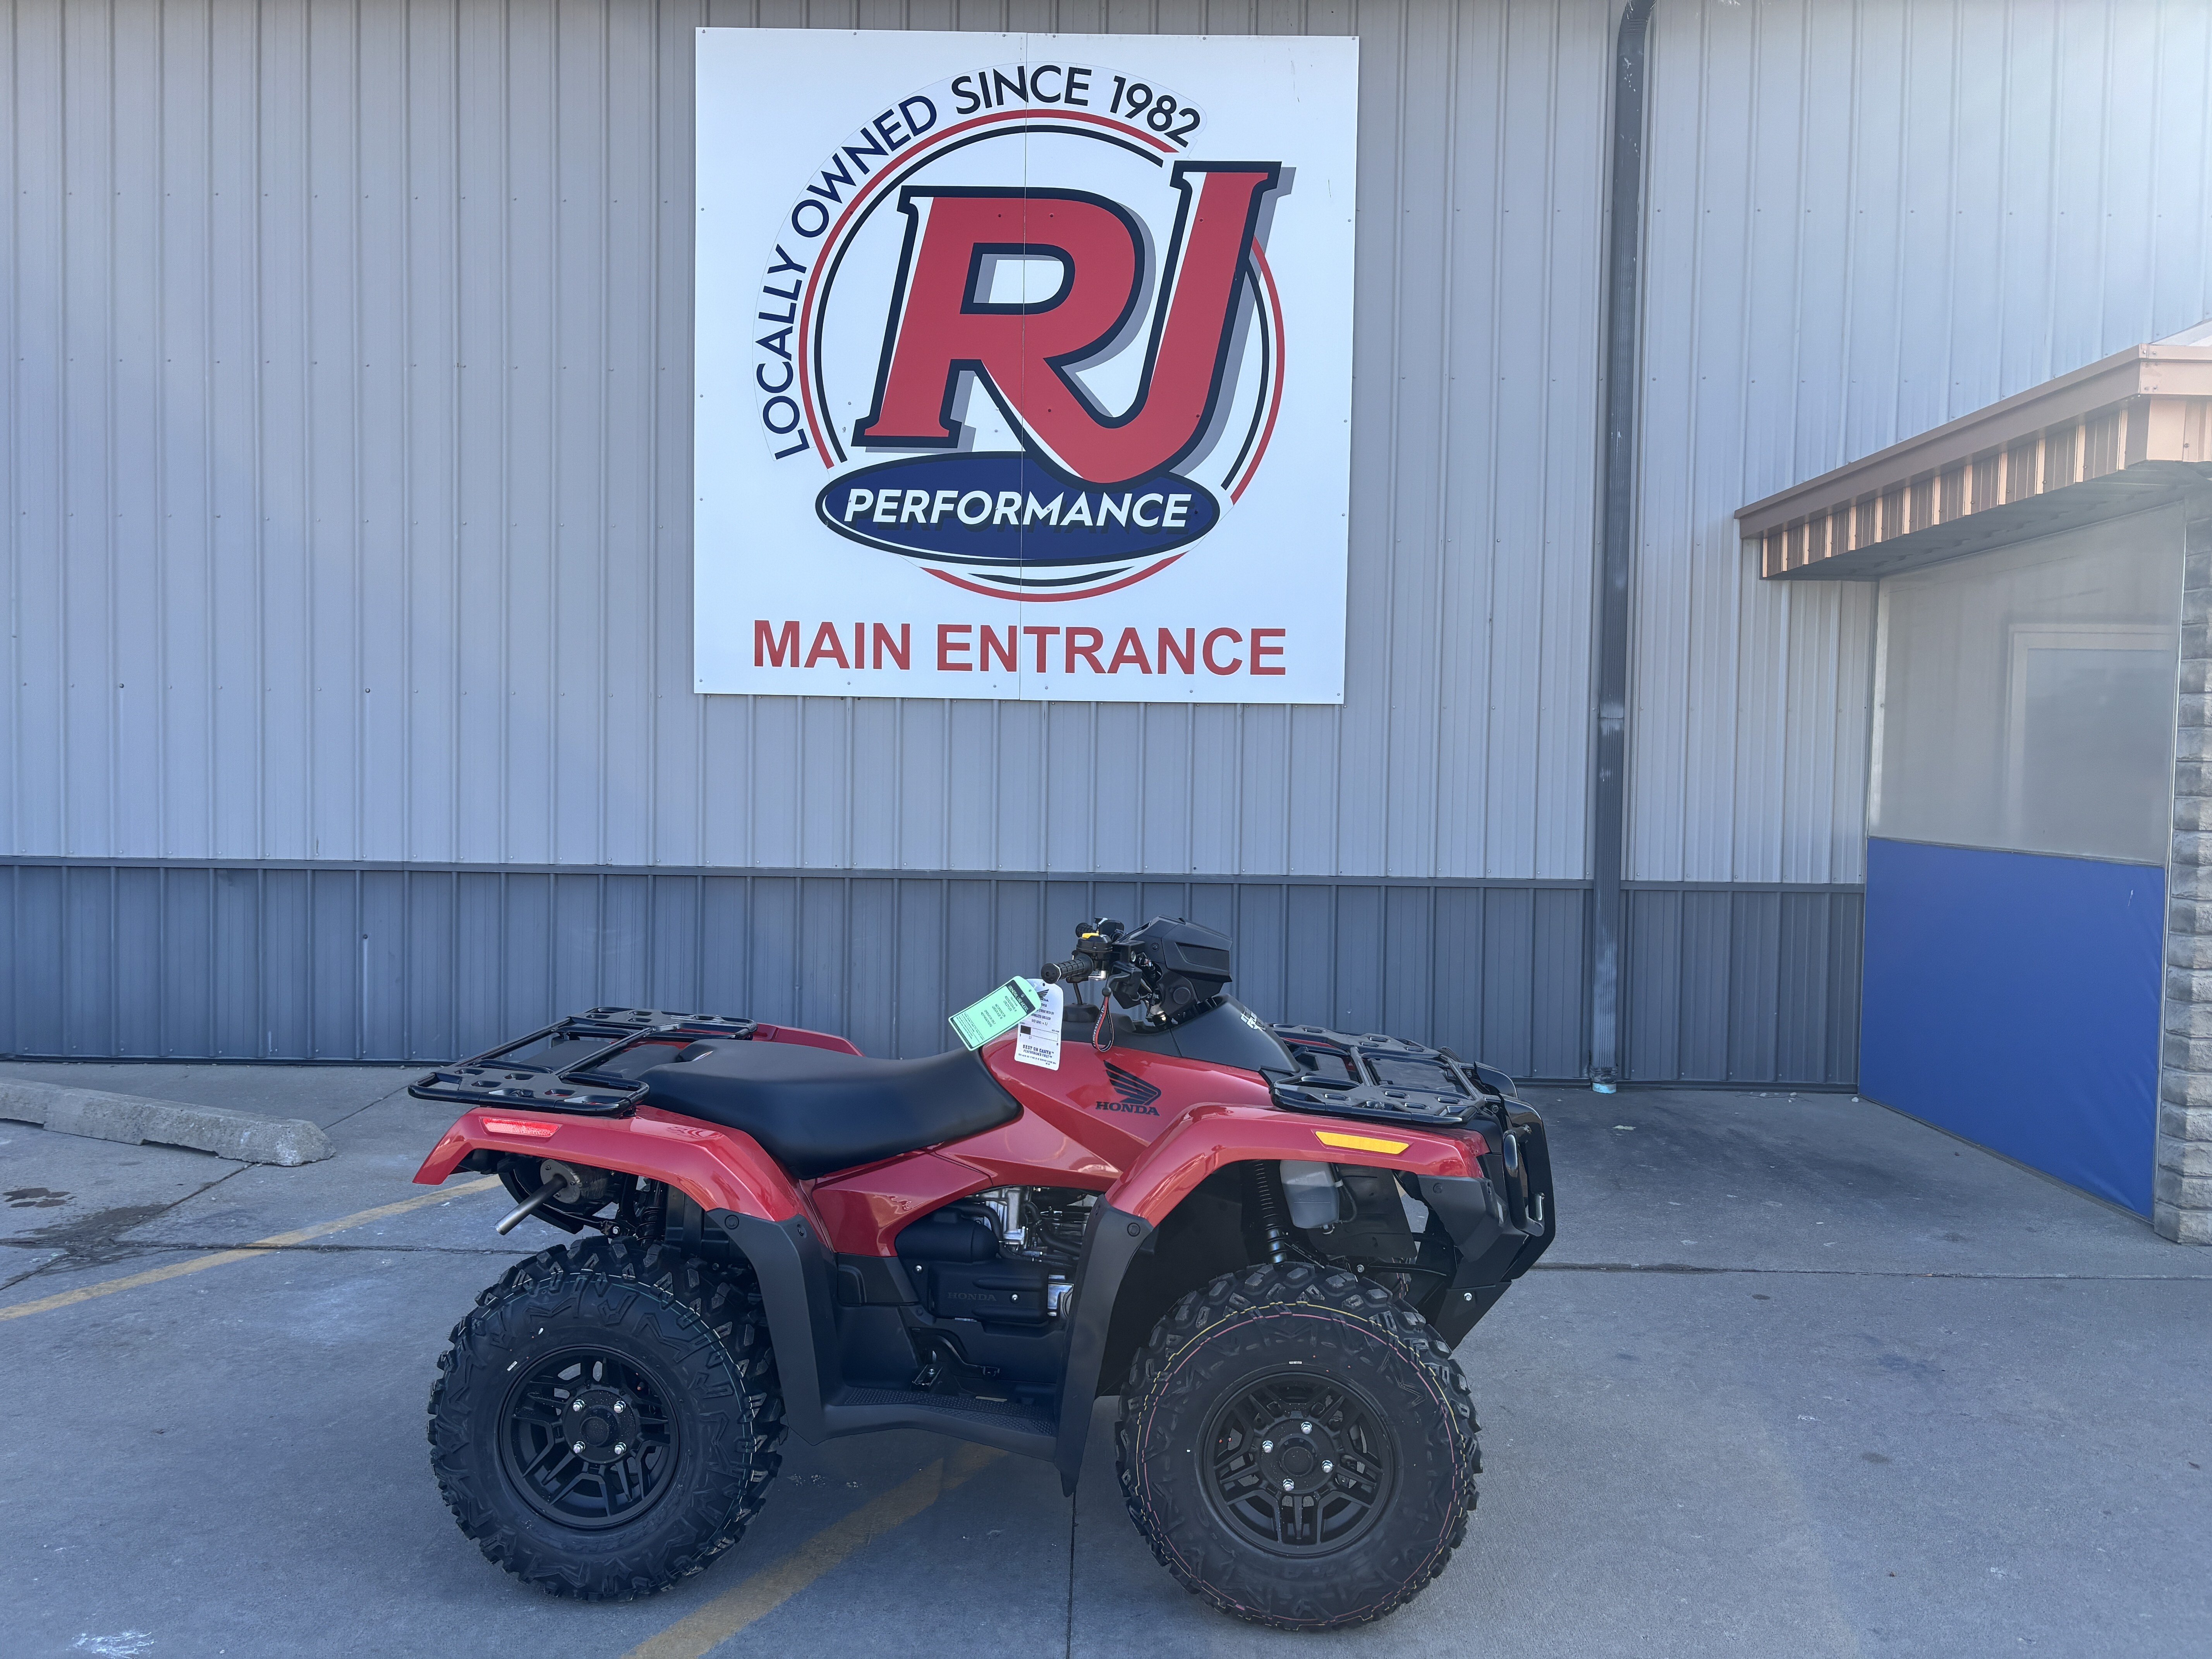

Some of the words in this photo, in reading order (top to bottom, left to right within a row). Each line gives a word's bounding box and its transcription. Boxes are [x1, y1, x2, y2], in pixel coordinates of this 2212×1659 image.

[755, 243, 810, 460] LOCALLY
[791, 96, 937, 238] OWNED
[951, 65, 1092, 115] SINCE
[1110, 75, 1200, 148] 1982
[850, 161, 1283, 491] RJ
[844, 489, 1192, 527] PERFORMANCE
[755, 621, 910, 670] MAIN
[938, 625, 1286, 675] ENTRANCE
[1095, 1101, 1160, 1116] HONDA
[947, 1292, 997, 1301] HONDA
